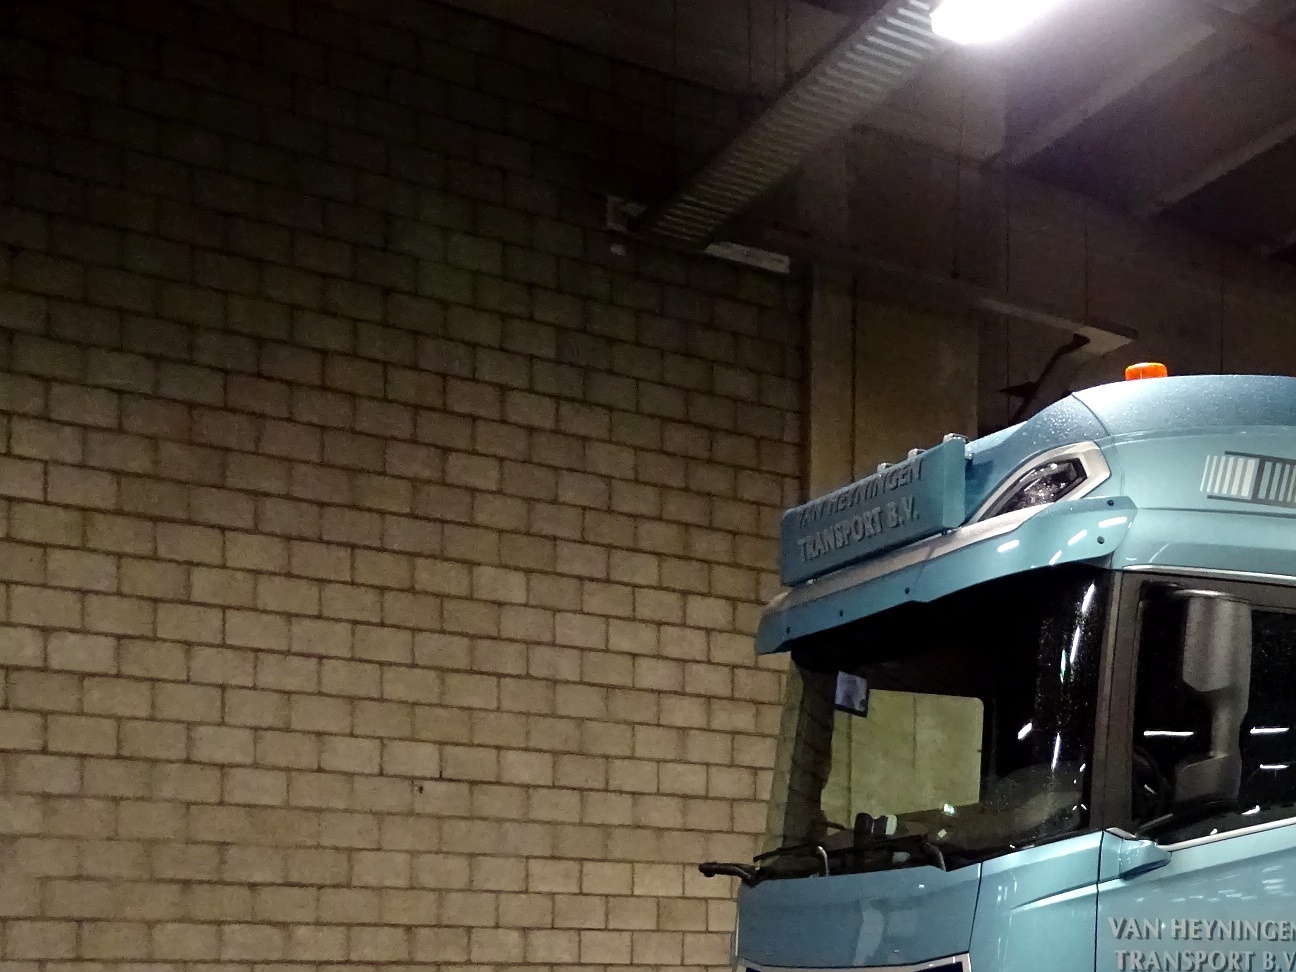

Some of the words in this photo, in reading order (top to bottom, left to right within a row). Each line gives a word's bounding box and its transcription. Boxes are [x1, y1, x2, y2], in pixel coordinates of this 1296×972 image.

[798, 501, 828, 529] VAN
[828, 459, 924, 516] HEYNINGEN
[798, 506, 883, 562] TRANSPORT
[885, 495, 920, 529] B.V.
[1108, 917, 1162, 941] VAN
[1115, 950, 1256, 972] TRANSPORT
